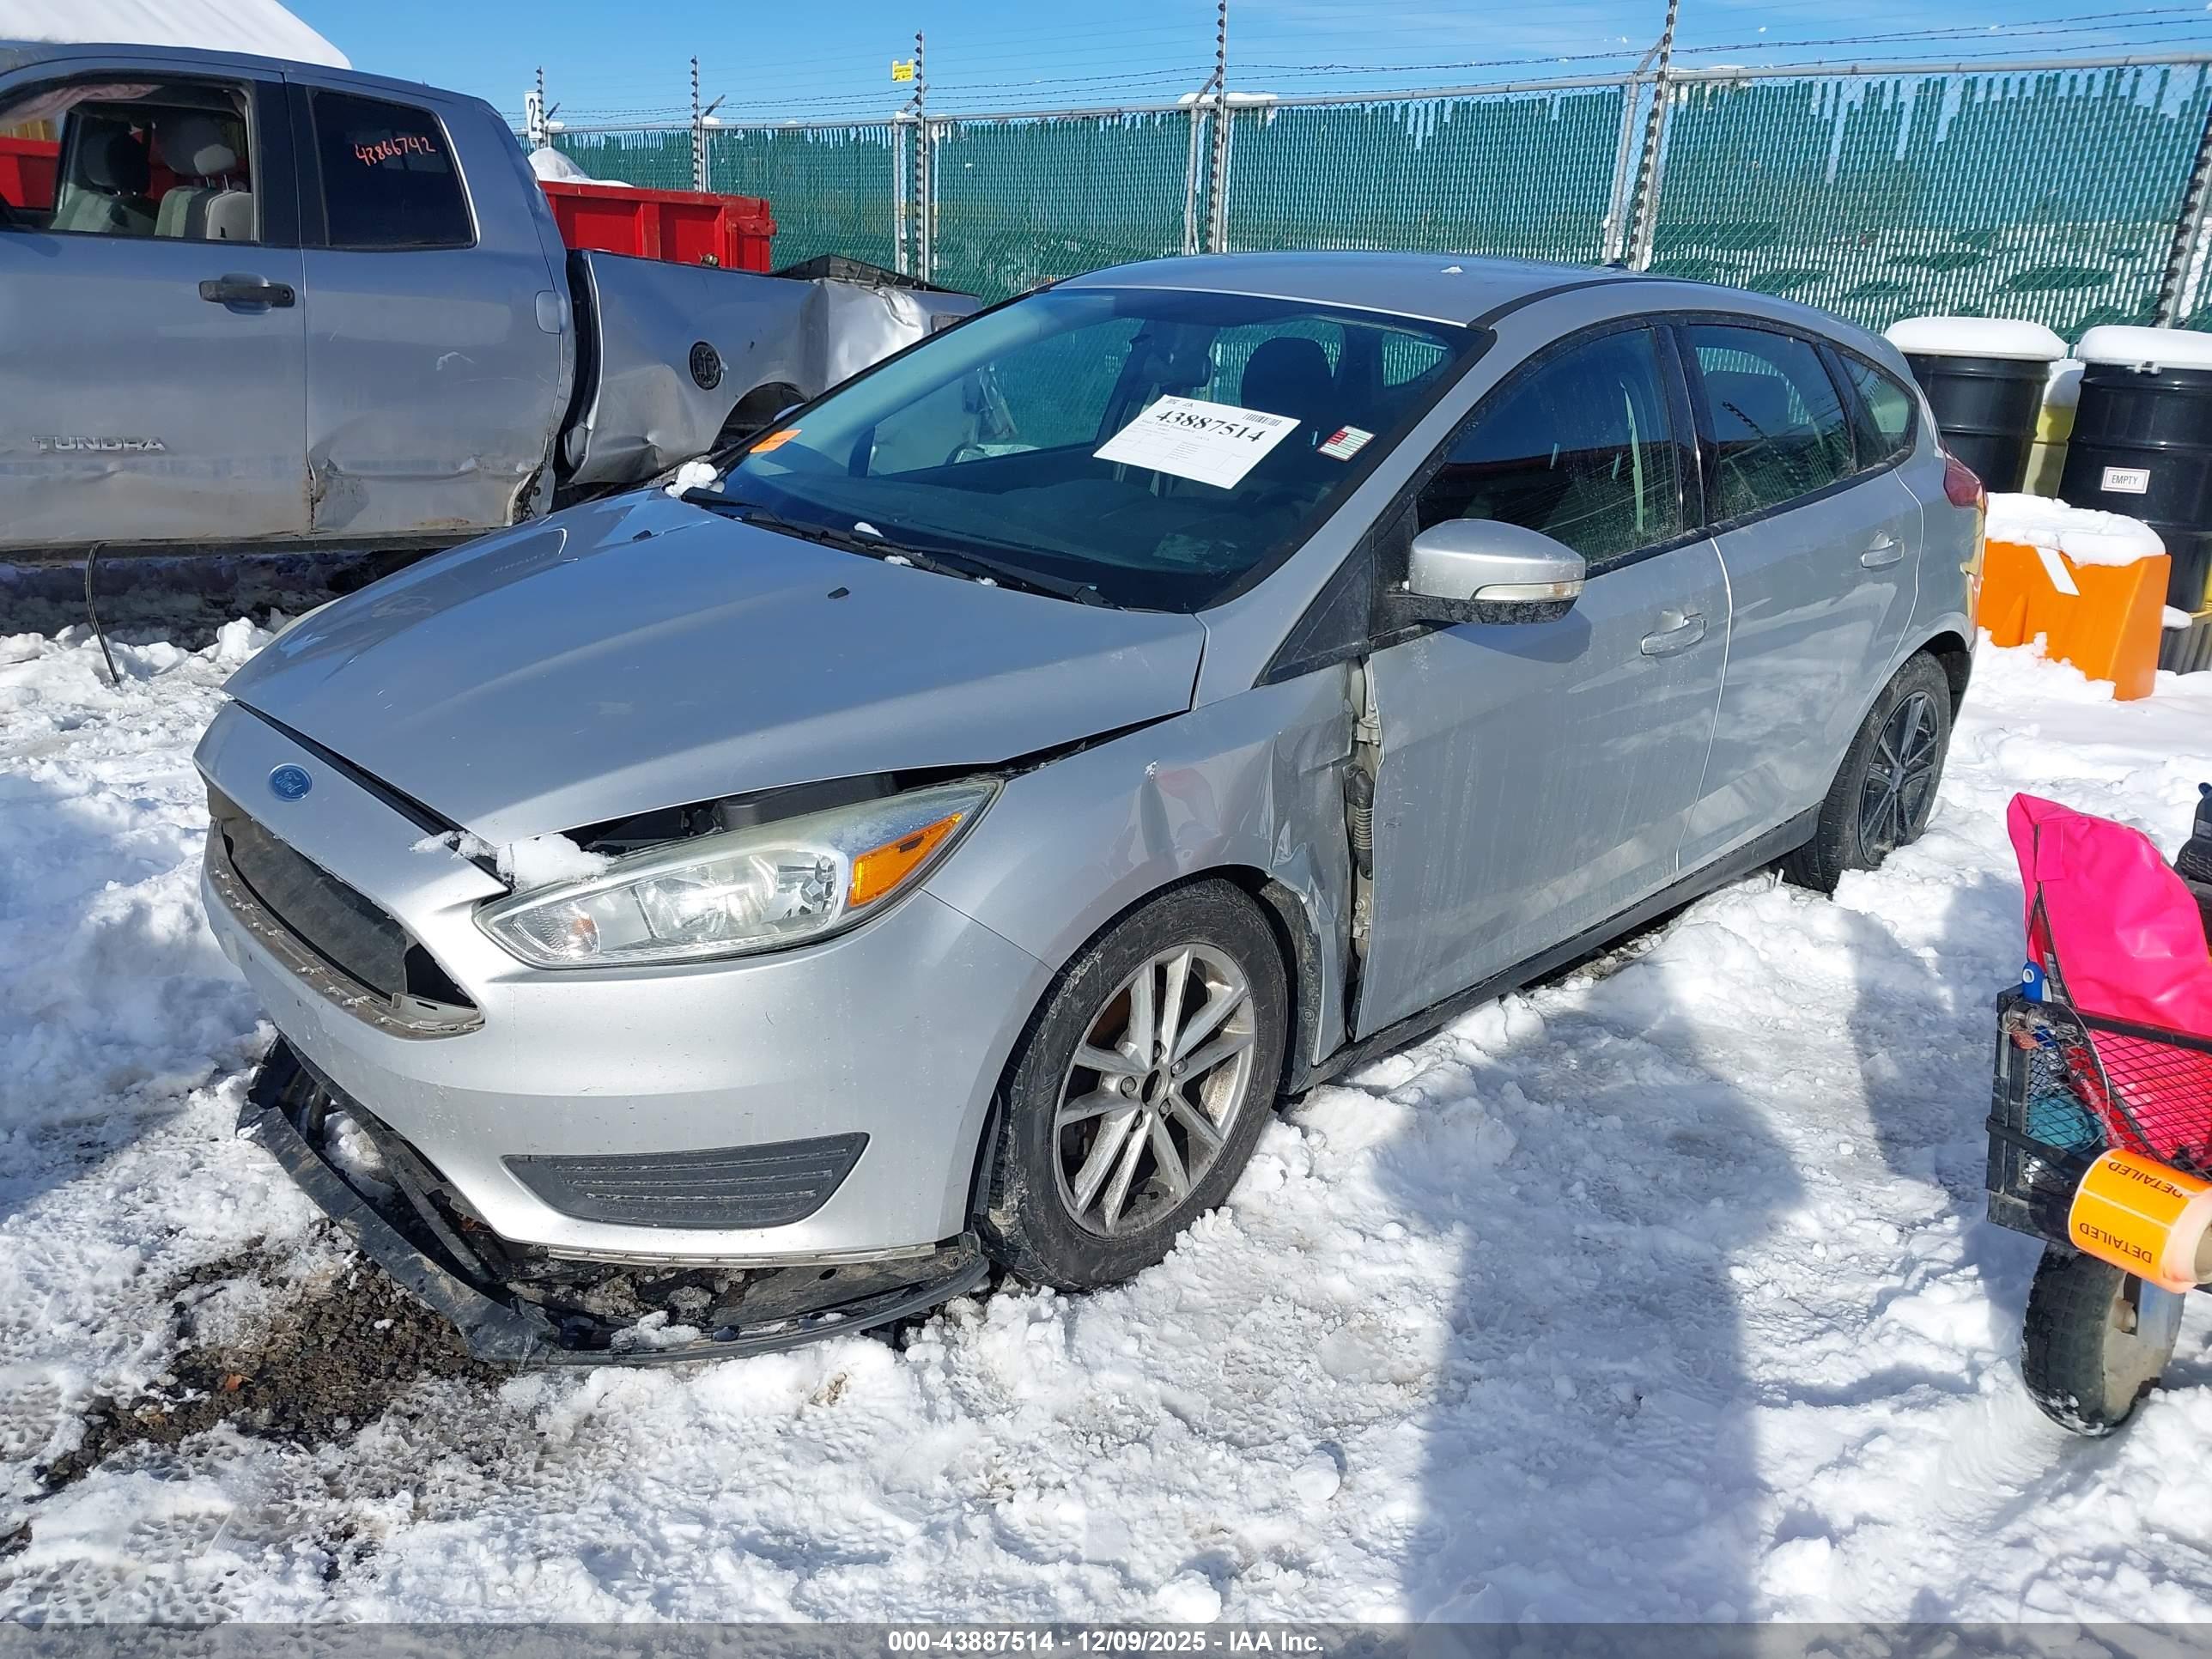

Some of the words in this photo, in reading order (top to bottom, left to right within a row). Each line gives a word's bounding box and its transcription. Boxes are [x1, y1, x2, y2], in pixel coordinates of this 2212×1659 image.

[528, 97, 538, 132] 2
[1155, 410, 1267, 442] 43887514
[32, 434, 167, 452] TUNDRA
[2112, 474, 2139, 485] EMPTY
[275, 771, 303, 794] Ford
[2079, 1222, 2154, 1264] DETAILED
